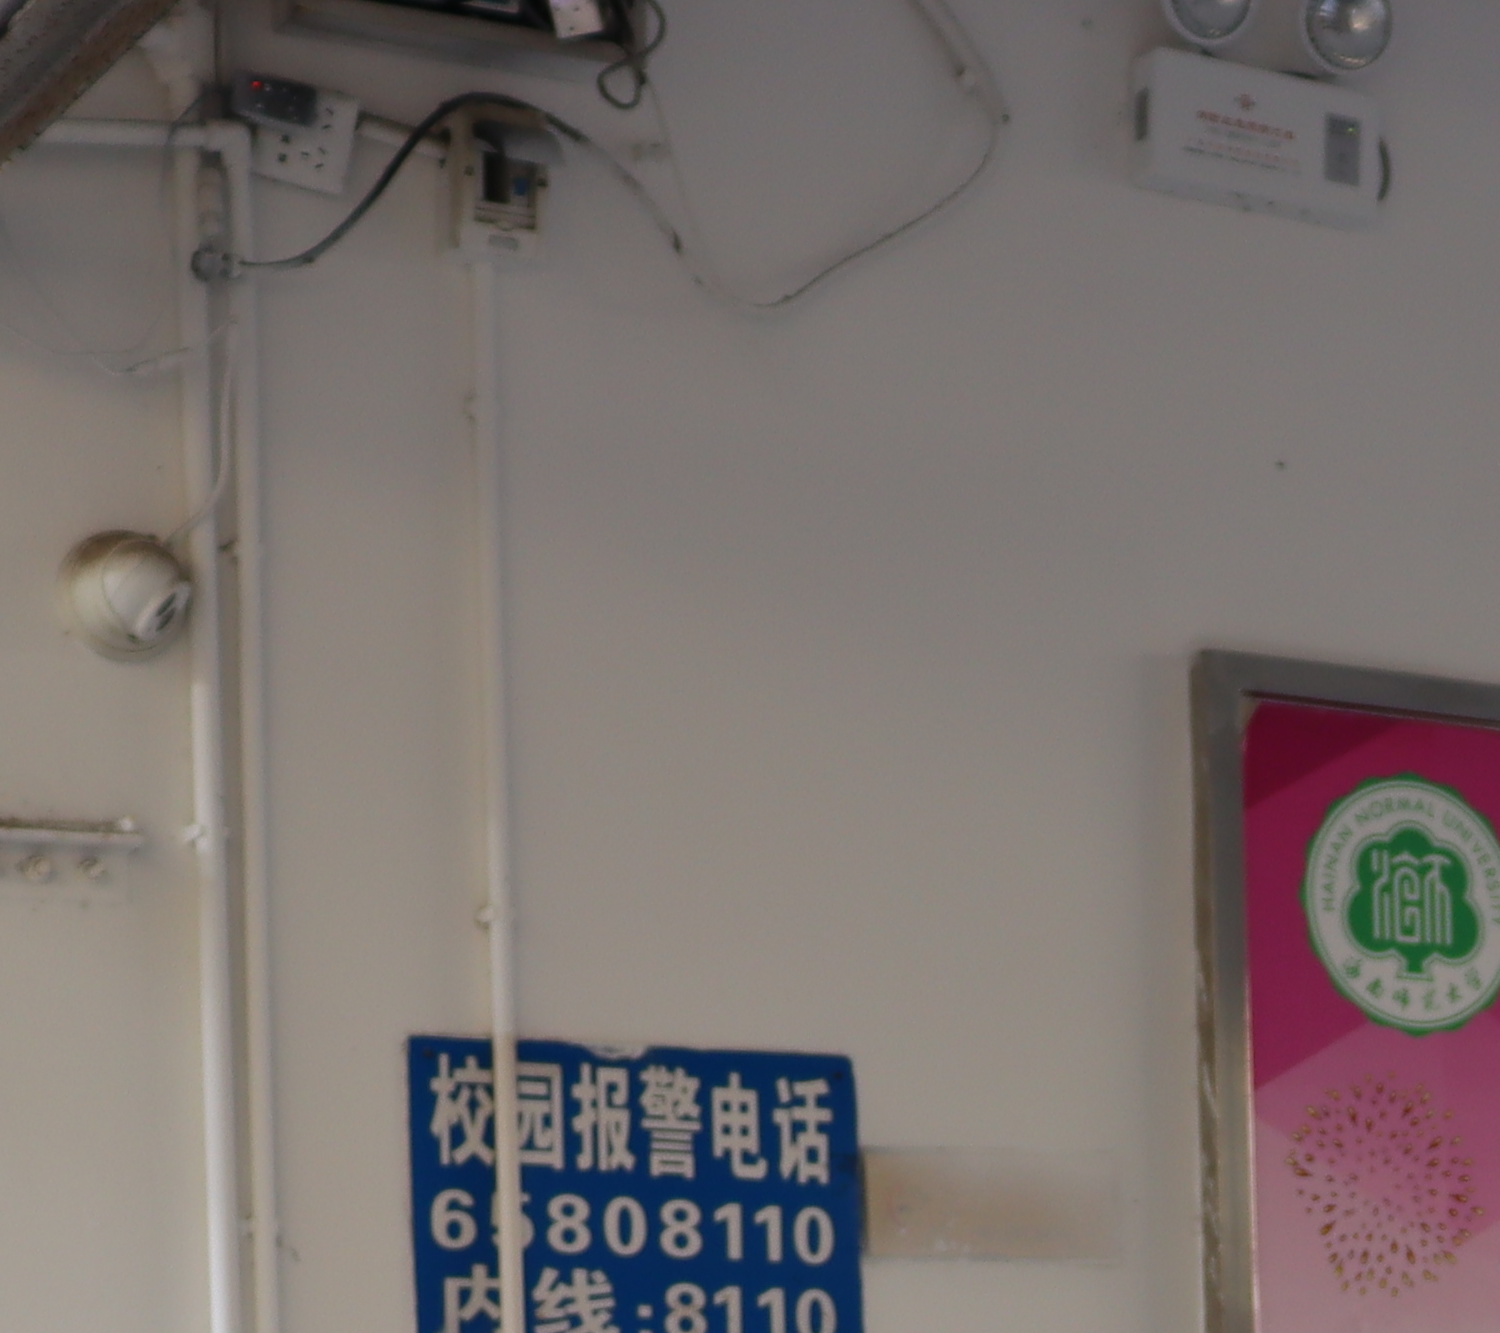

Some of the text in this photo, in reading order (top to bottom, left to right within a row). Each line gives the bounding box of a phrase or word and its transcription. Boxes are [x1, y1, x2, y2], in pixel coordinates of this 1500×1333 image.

[1321, 828, 1353, 912] HAINAN
[1354, 797, 1435, 824] NORMAL
[430, 1053, 833, 1184] 校园报警电话
